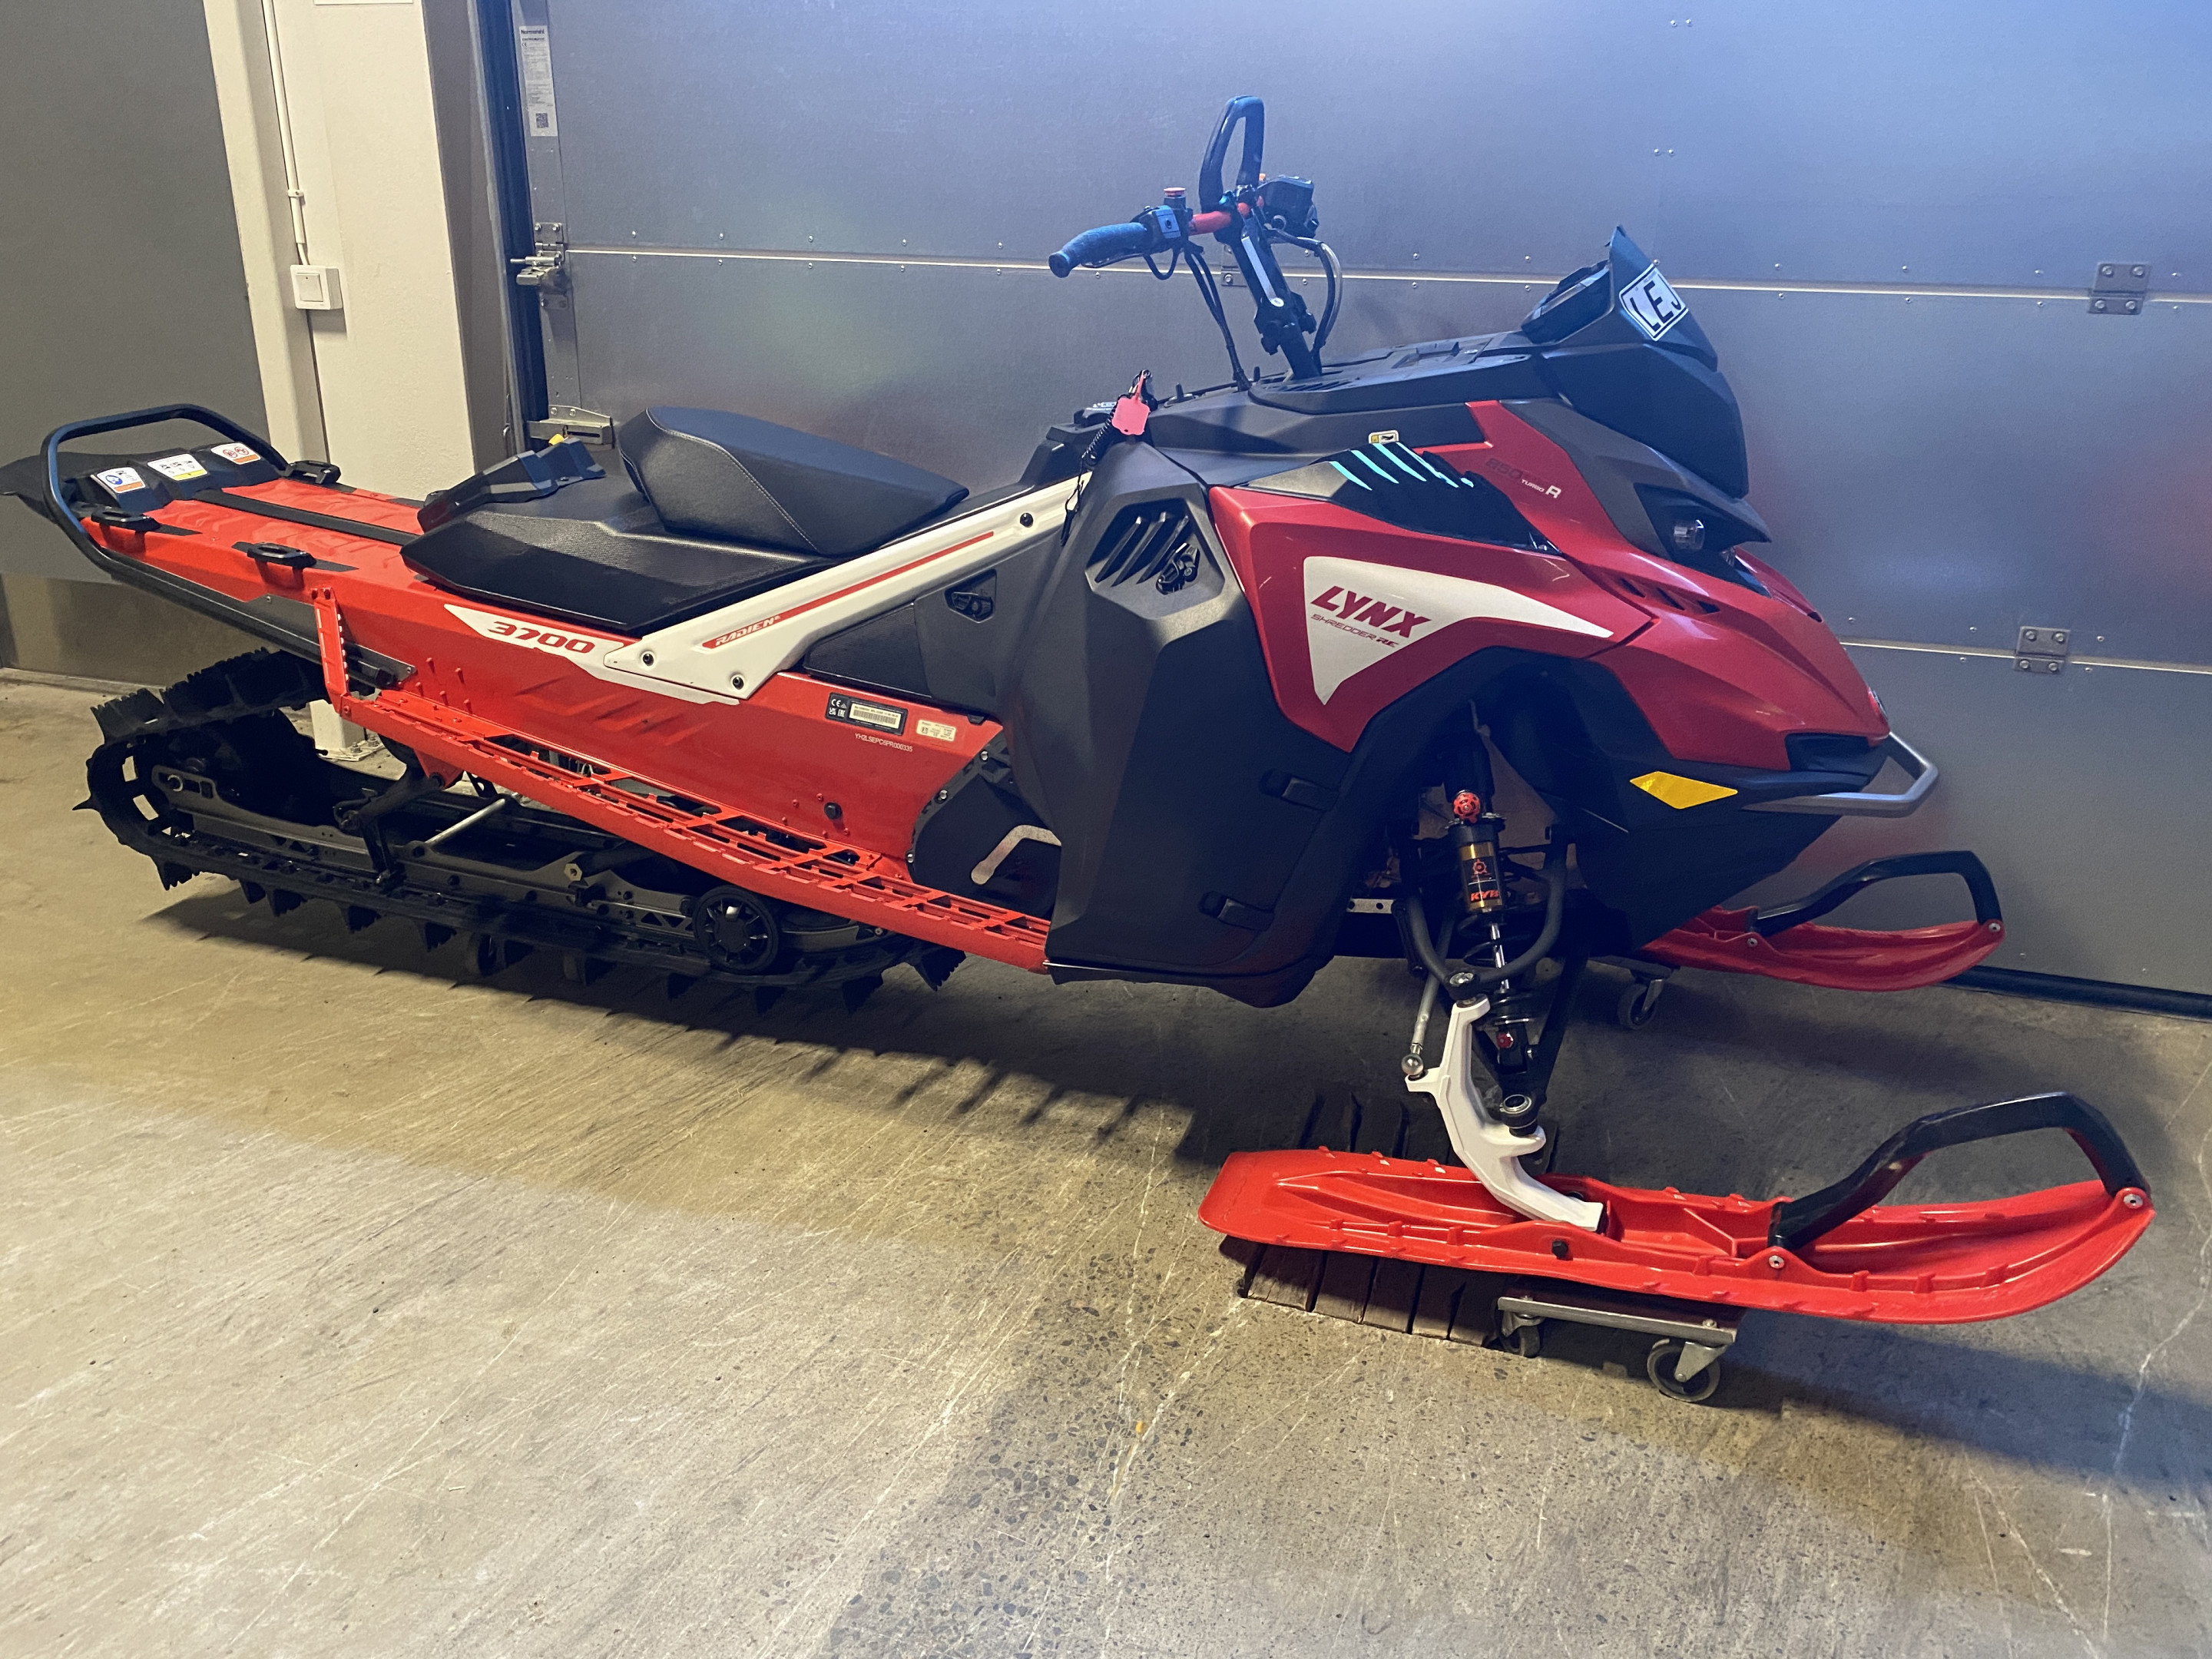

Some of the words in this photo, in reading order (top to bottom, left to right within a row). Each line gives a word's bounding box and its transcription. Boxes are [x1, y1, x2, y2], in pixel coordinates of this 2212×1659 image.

[1522, 478, 1545, 492] TURBO
[1545, 485, 1562, 499] R
[1310, 585, 1432, 638] LYNX
[487, 621, 596, 654] 3700
[1310, 614, 1377, 641] SHREDDER
[1470, 890, 1499, 901] KYB
